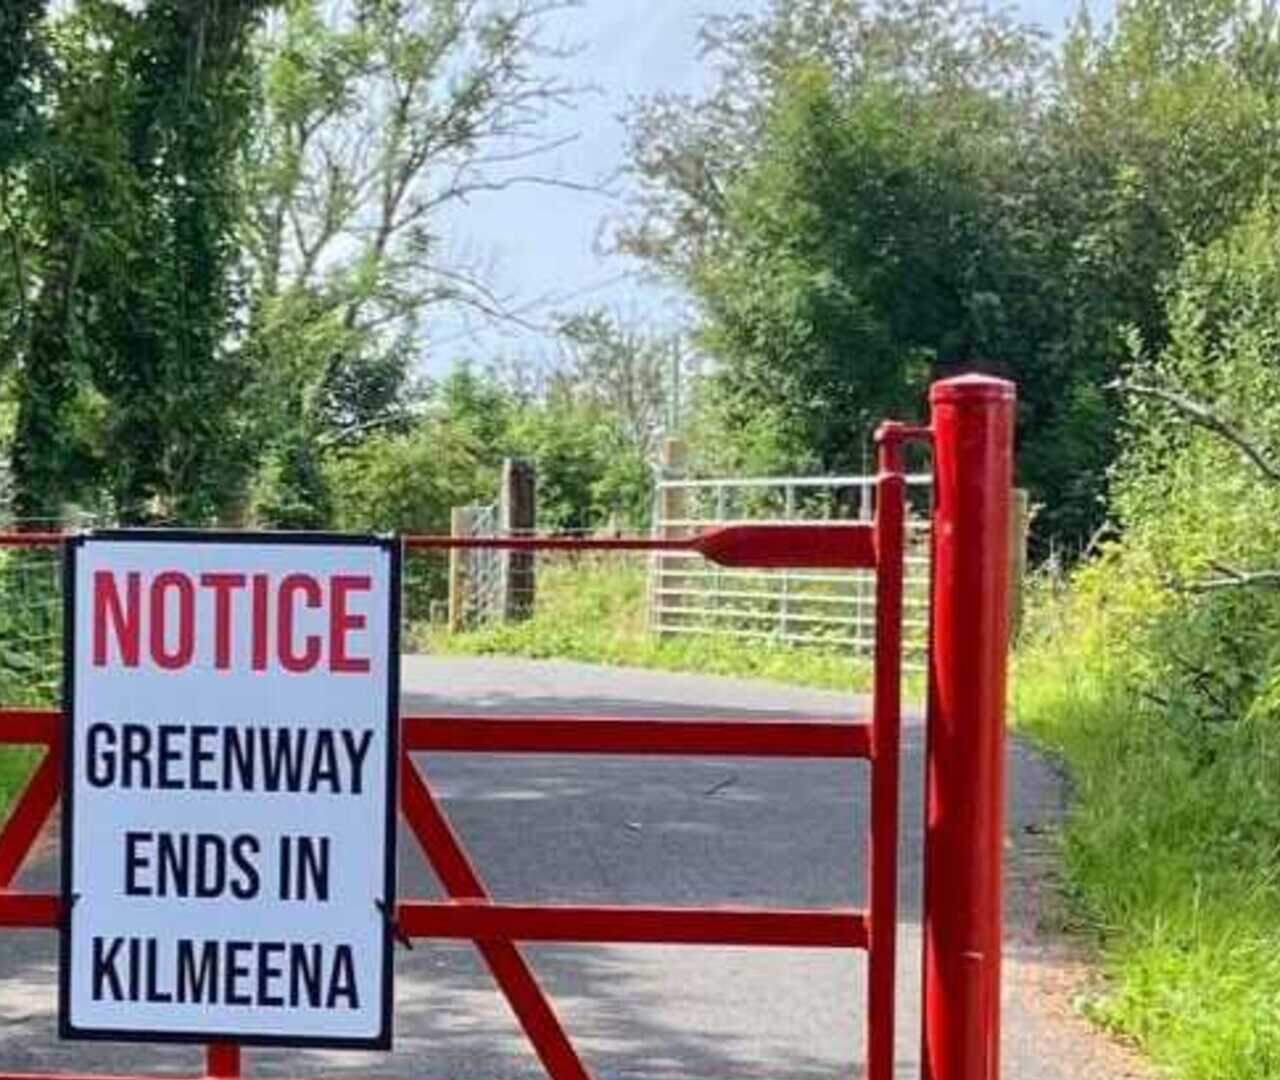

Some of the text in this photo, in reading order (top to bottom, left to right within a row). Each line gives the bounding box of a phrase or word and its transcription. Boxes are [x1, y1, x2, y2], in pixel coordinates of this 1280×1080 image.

[92, 571, 372, 674] NOTICE
[86, 722, 374, 795] GREENWAY
[125, 831, 330, 902] ENDS IN
[92, 936, 360, 1009] KILMEENA
